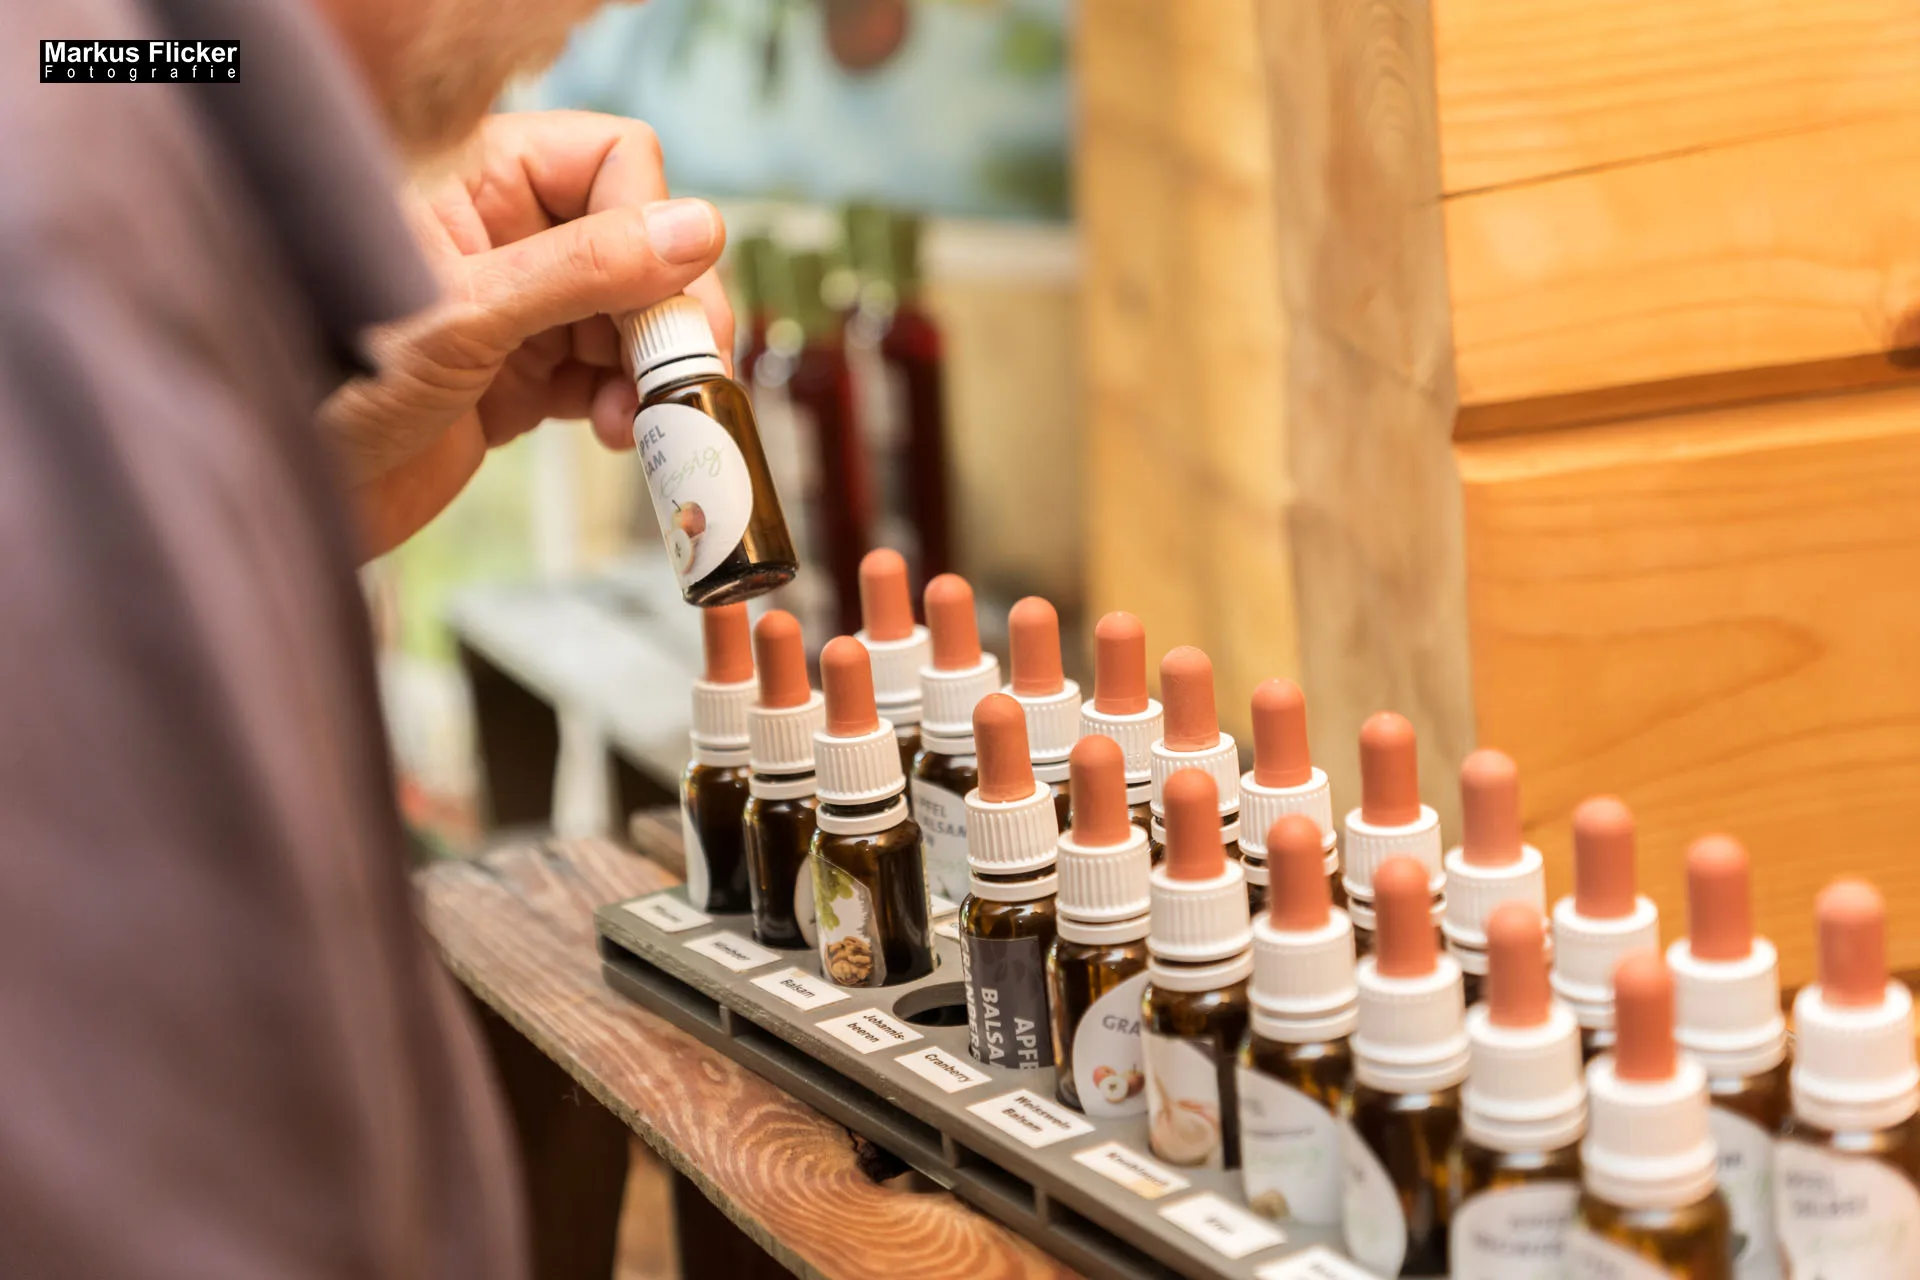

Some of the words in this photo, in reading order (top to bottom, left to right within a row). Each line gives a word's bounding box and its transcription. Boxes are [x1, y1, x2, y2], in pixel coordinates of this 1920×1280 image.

[779, 979, 816, 999] Balsam
[846, 1022, 880, 1043] beeren
[863, 1015, 905, 1041] Johannis-
[981, 987, 1007, 1069] BALSA
[924, 1053, 973, 1083] Cranberry
